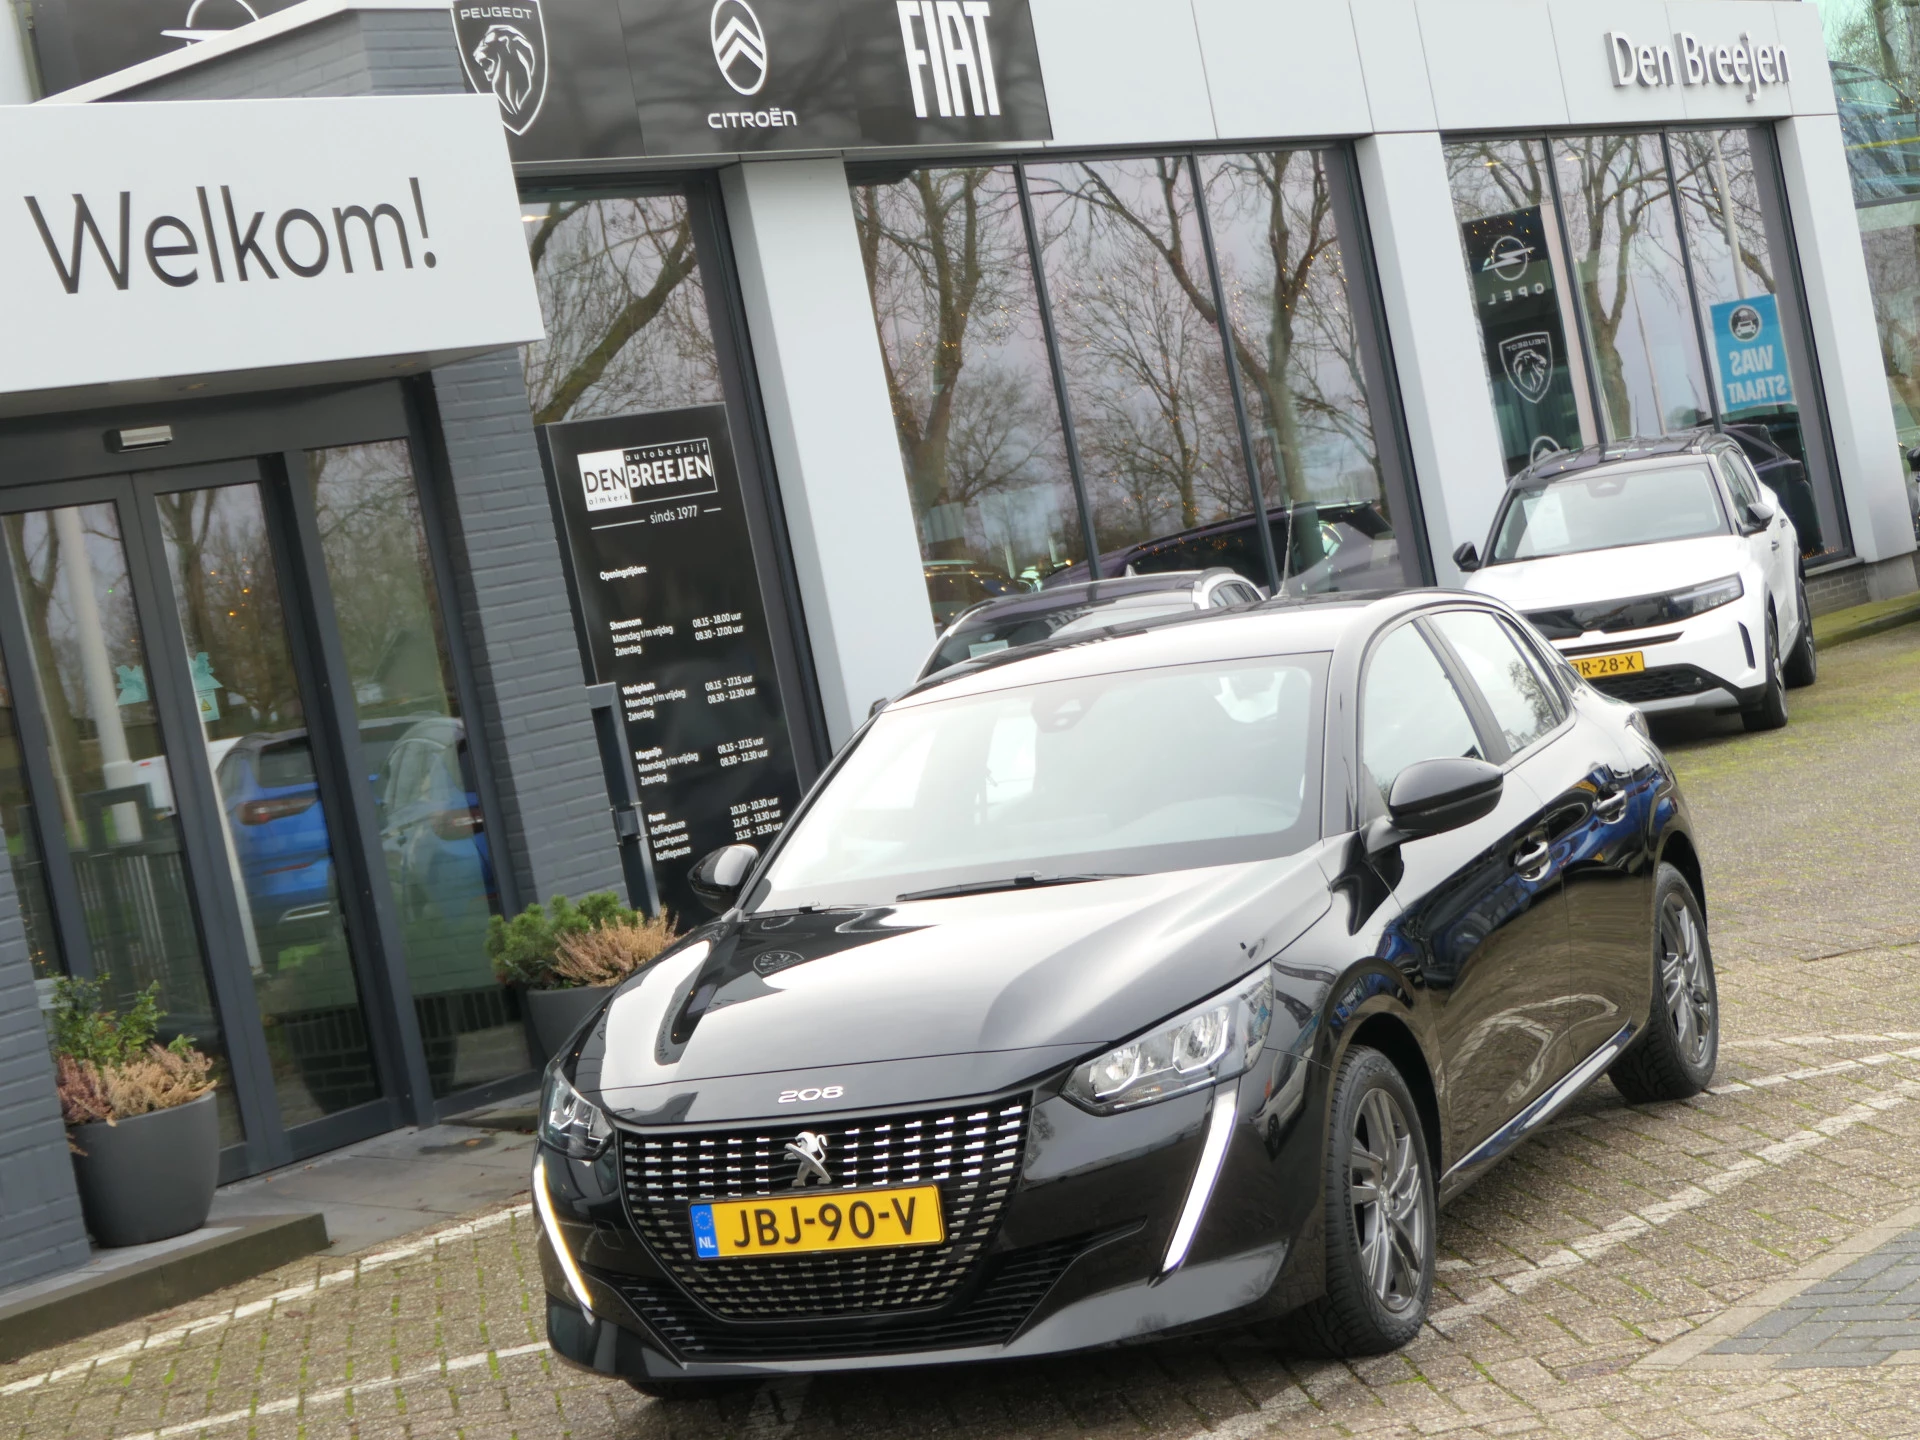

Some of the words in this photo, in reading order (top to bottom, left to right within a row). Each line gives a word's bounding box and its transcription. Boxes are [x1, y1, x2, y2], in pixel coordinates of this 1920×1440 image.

[460, 7, 532, 20] PEUGEOT
[896, 0, 1001, 118] FIAT
[1604, 31, 1678, 88] Den
[1674, 31, 1793, 103] Breejen
[24, 176, 437, 295] Welkom!
[625, 442, 707, 462] autobedrijf
[650, 510, 676, 524] sinds
[677, 505, 698, 520] 1977
[610, 618, 642, 631] Showroom
[778, 1086, 844, 1104] 208
[698, 1237, 716, 1250] NL
[734, 1196, 916, 1248] JBJ-90-V
